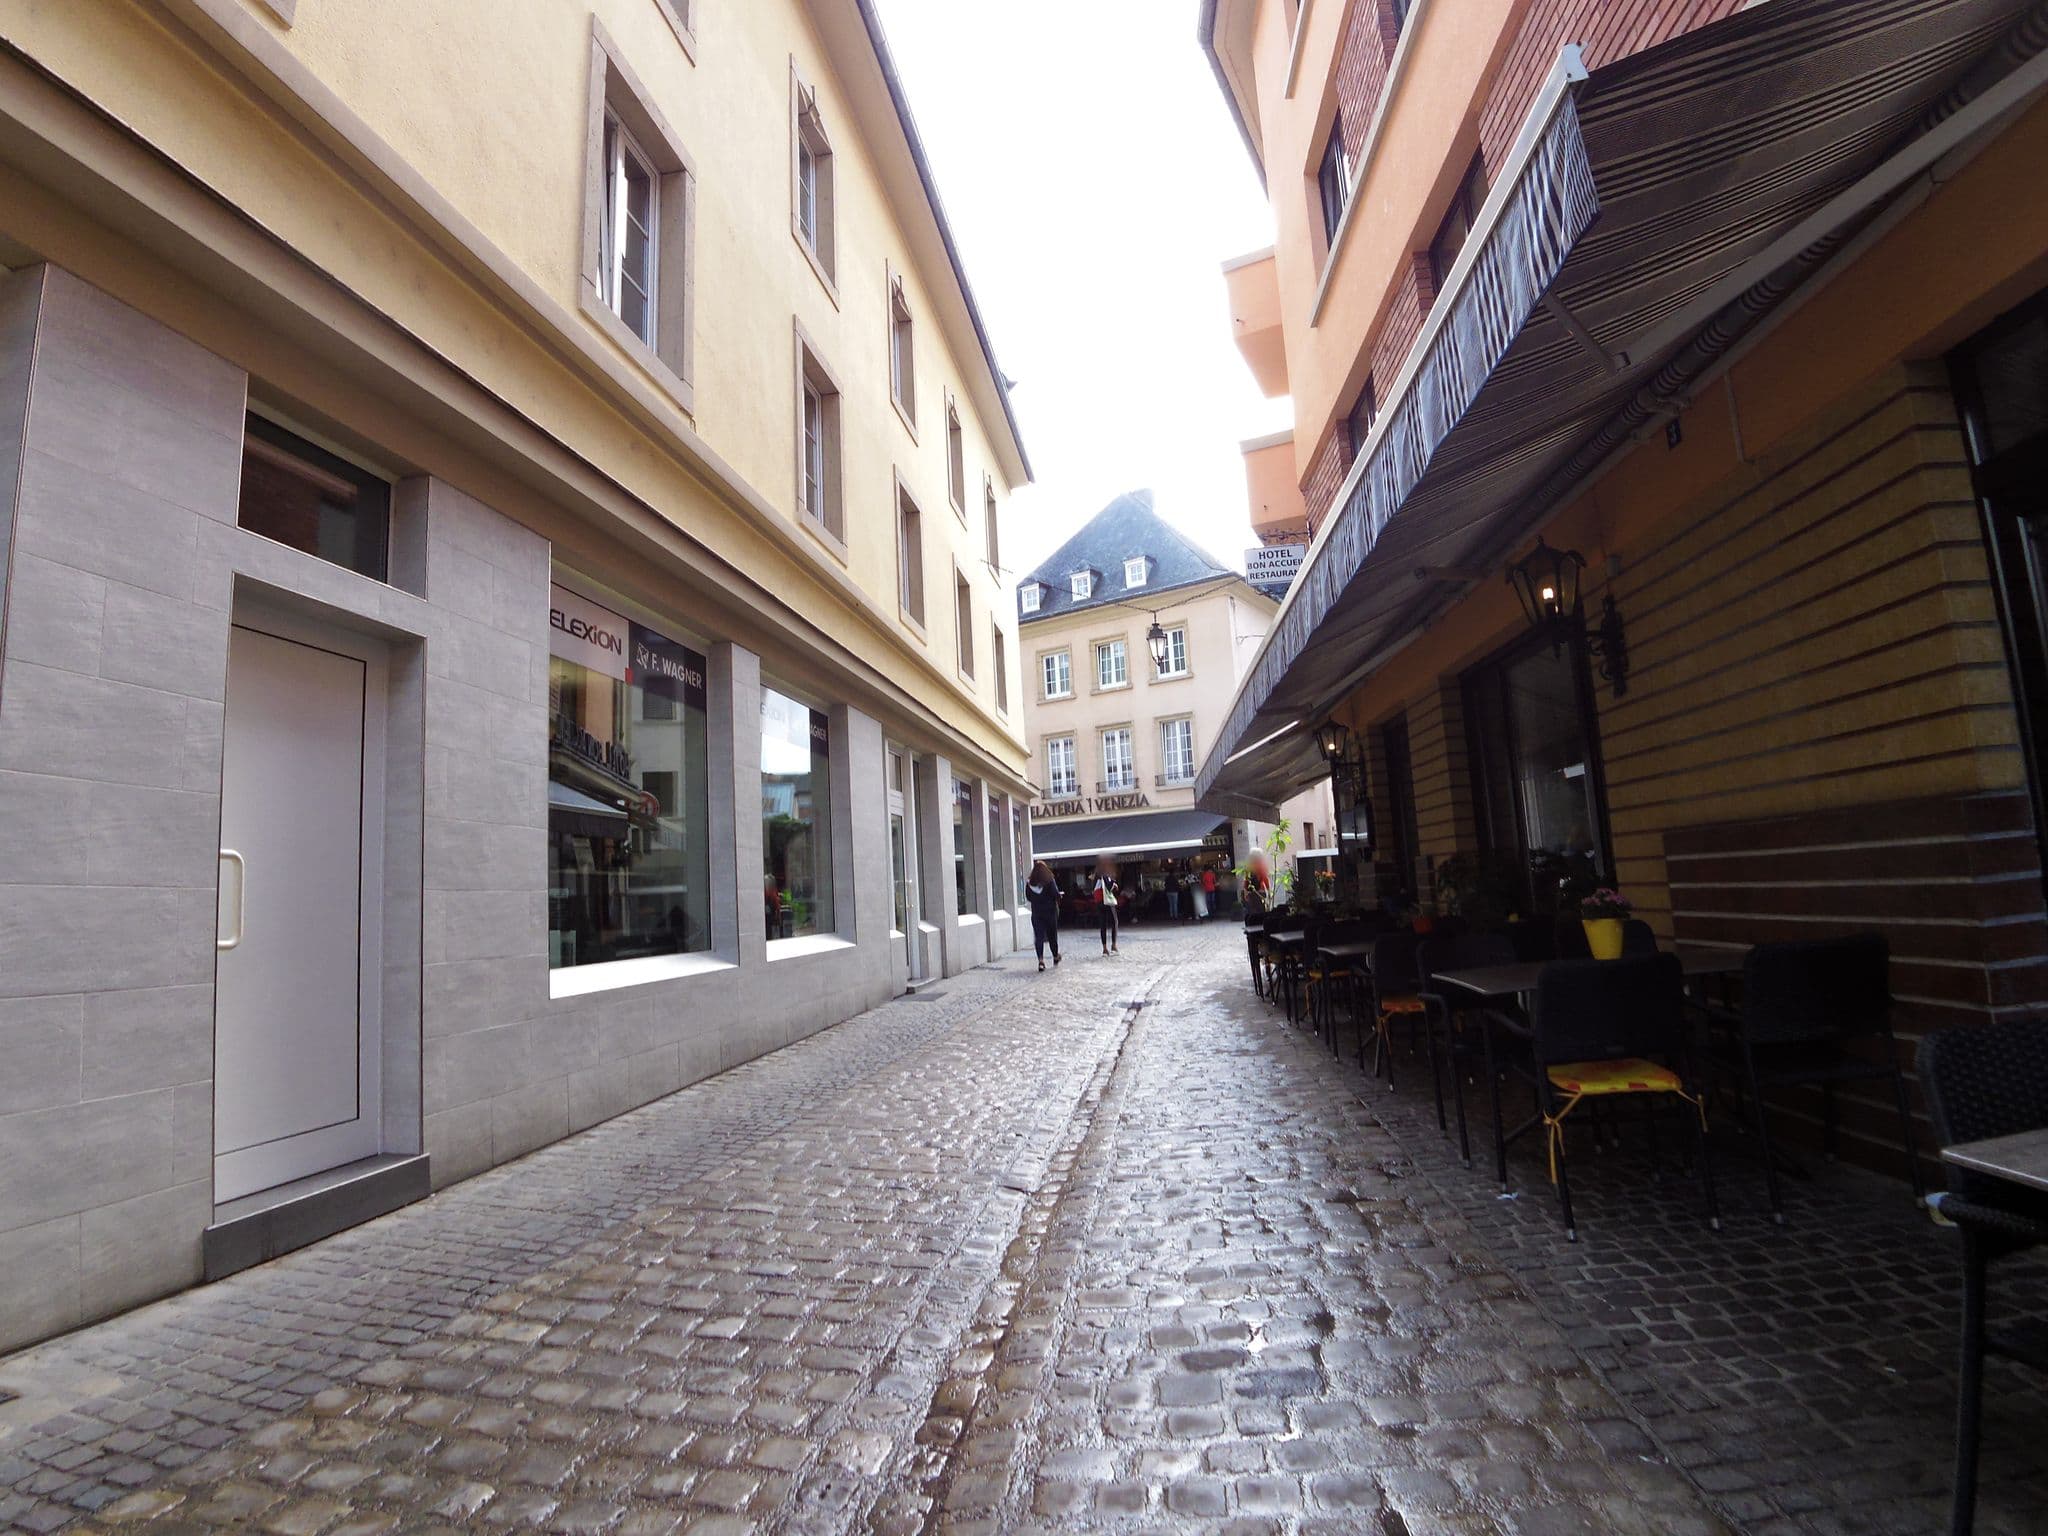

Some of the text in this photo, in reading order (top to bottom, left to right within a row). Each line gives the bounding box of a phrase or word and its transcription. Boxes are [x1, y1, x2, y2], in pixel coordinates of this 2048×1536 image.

[1258, 549, 1293, 560] HOTEL
[1247, 561, 1266, 570] BON
[1249, 569, 1298, 580] RESTAURAN
[651, 653, 703, 690] F. WAGNER
[809, 723, 827, 742] AGNER
[1031, 799, 1085, 819] ELATERIA
[1094, 793, 1150, 812] VENEZIA
